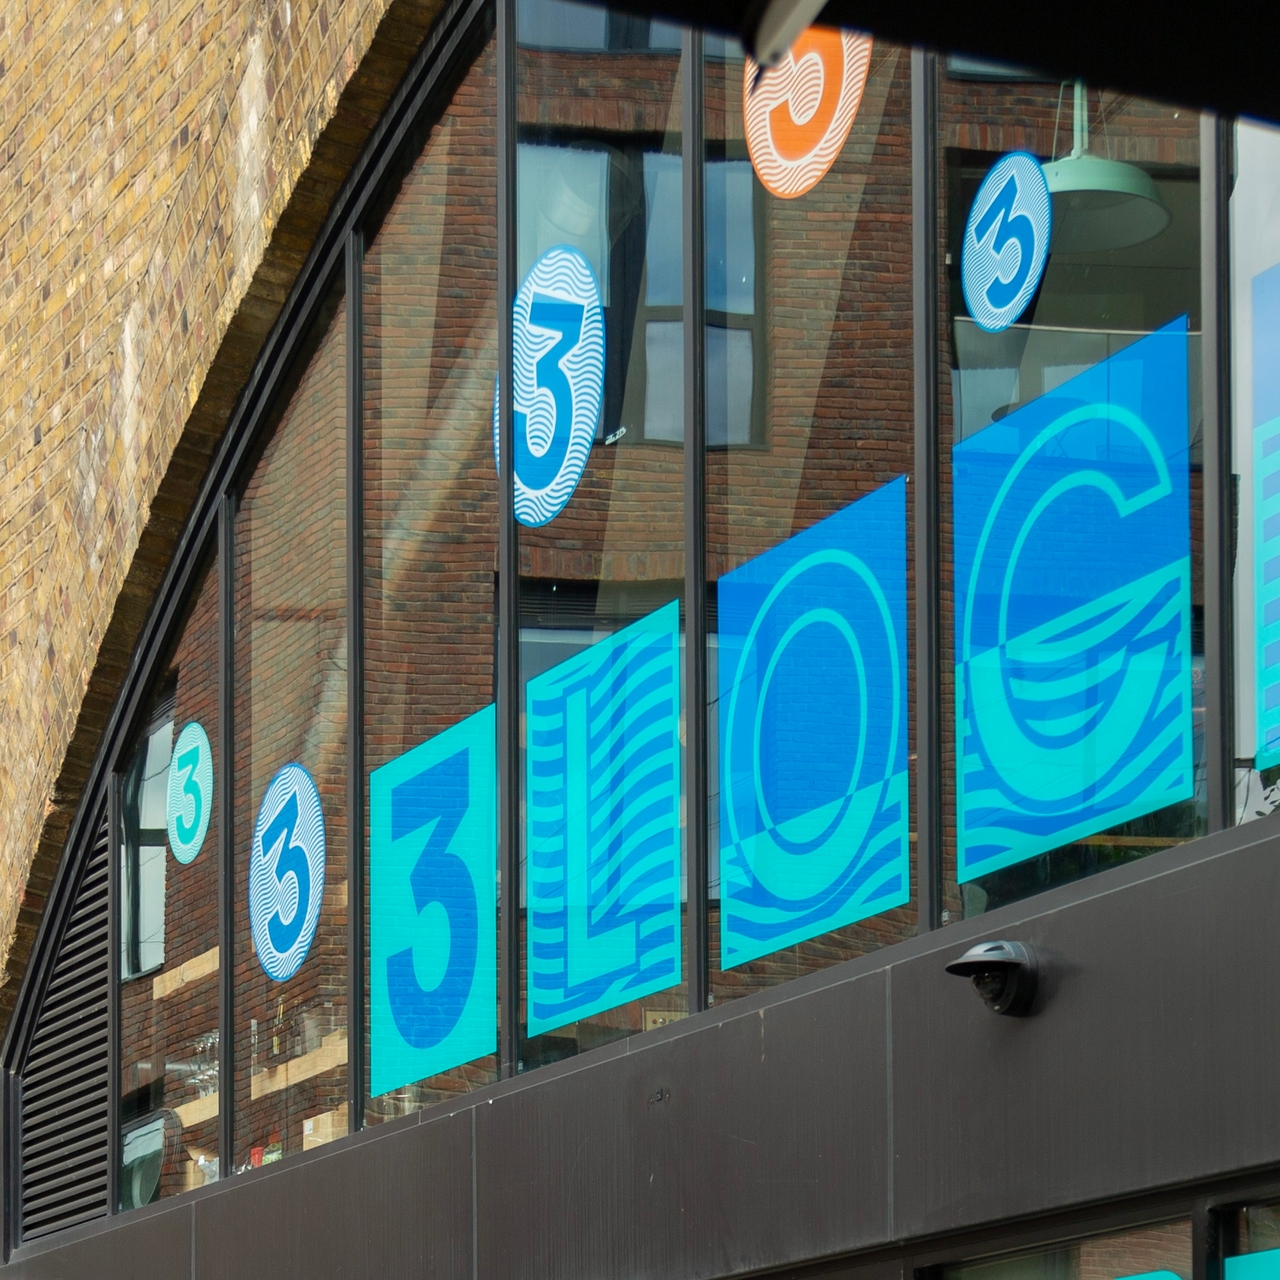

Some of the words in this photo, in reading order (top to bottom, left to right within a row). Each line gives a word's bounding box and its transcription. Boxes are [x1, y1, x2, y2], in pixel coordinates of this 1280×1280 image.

[974, 175, 1035, 311] 3
[513, 294, 586, 490] 3
[175, 746, 202, 848] 3
[261, 790, 310, 953] 3
